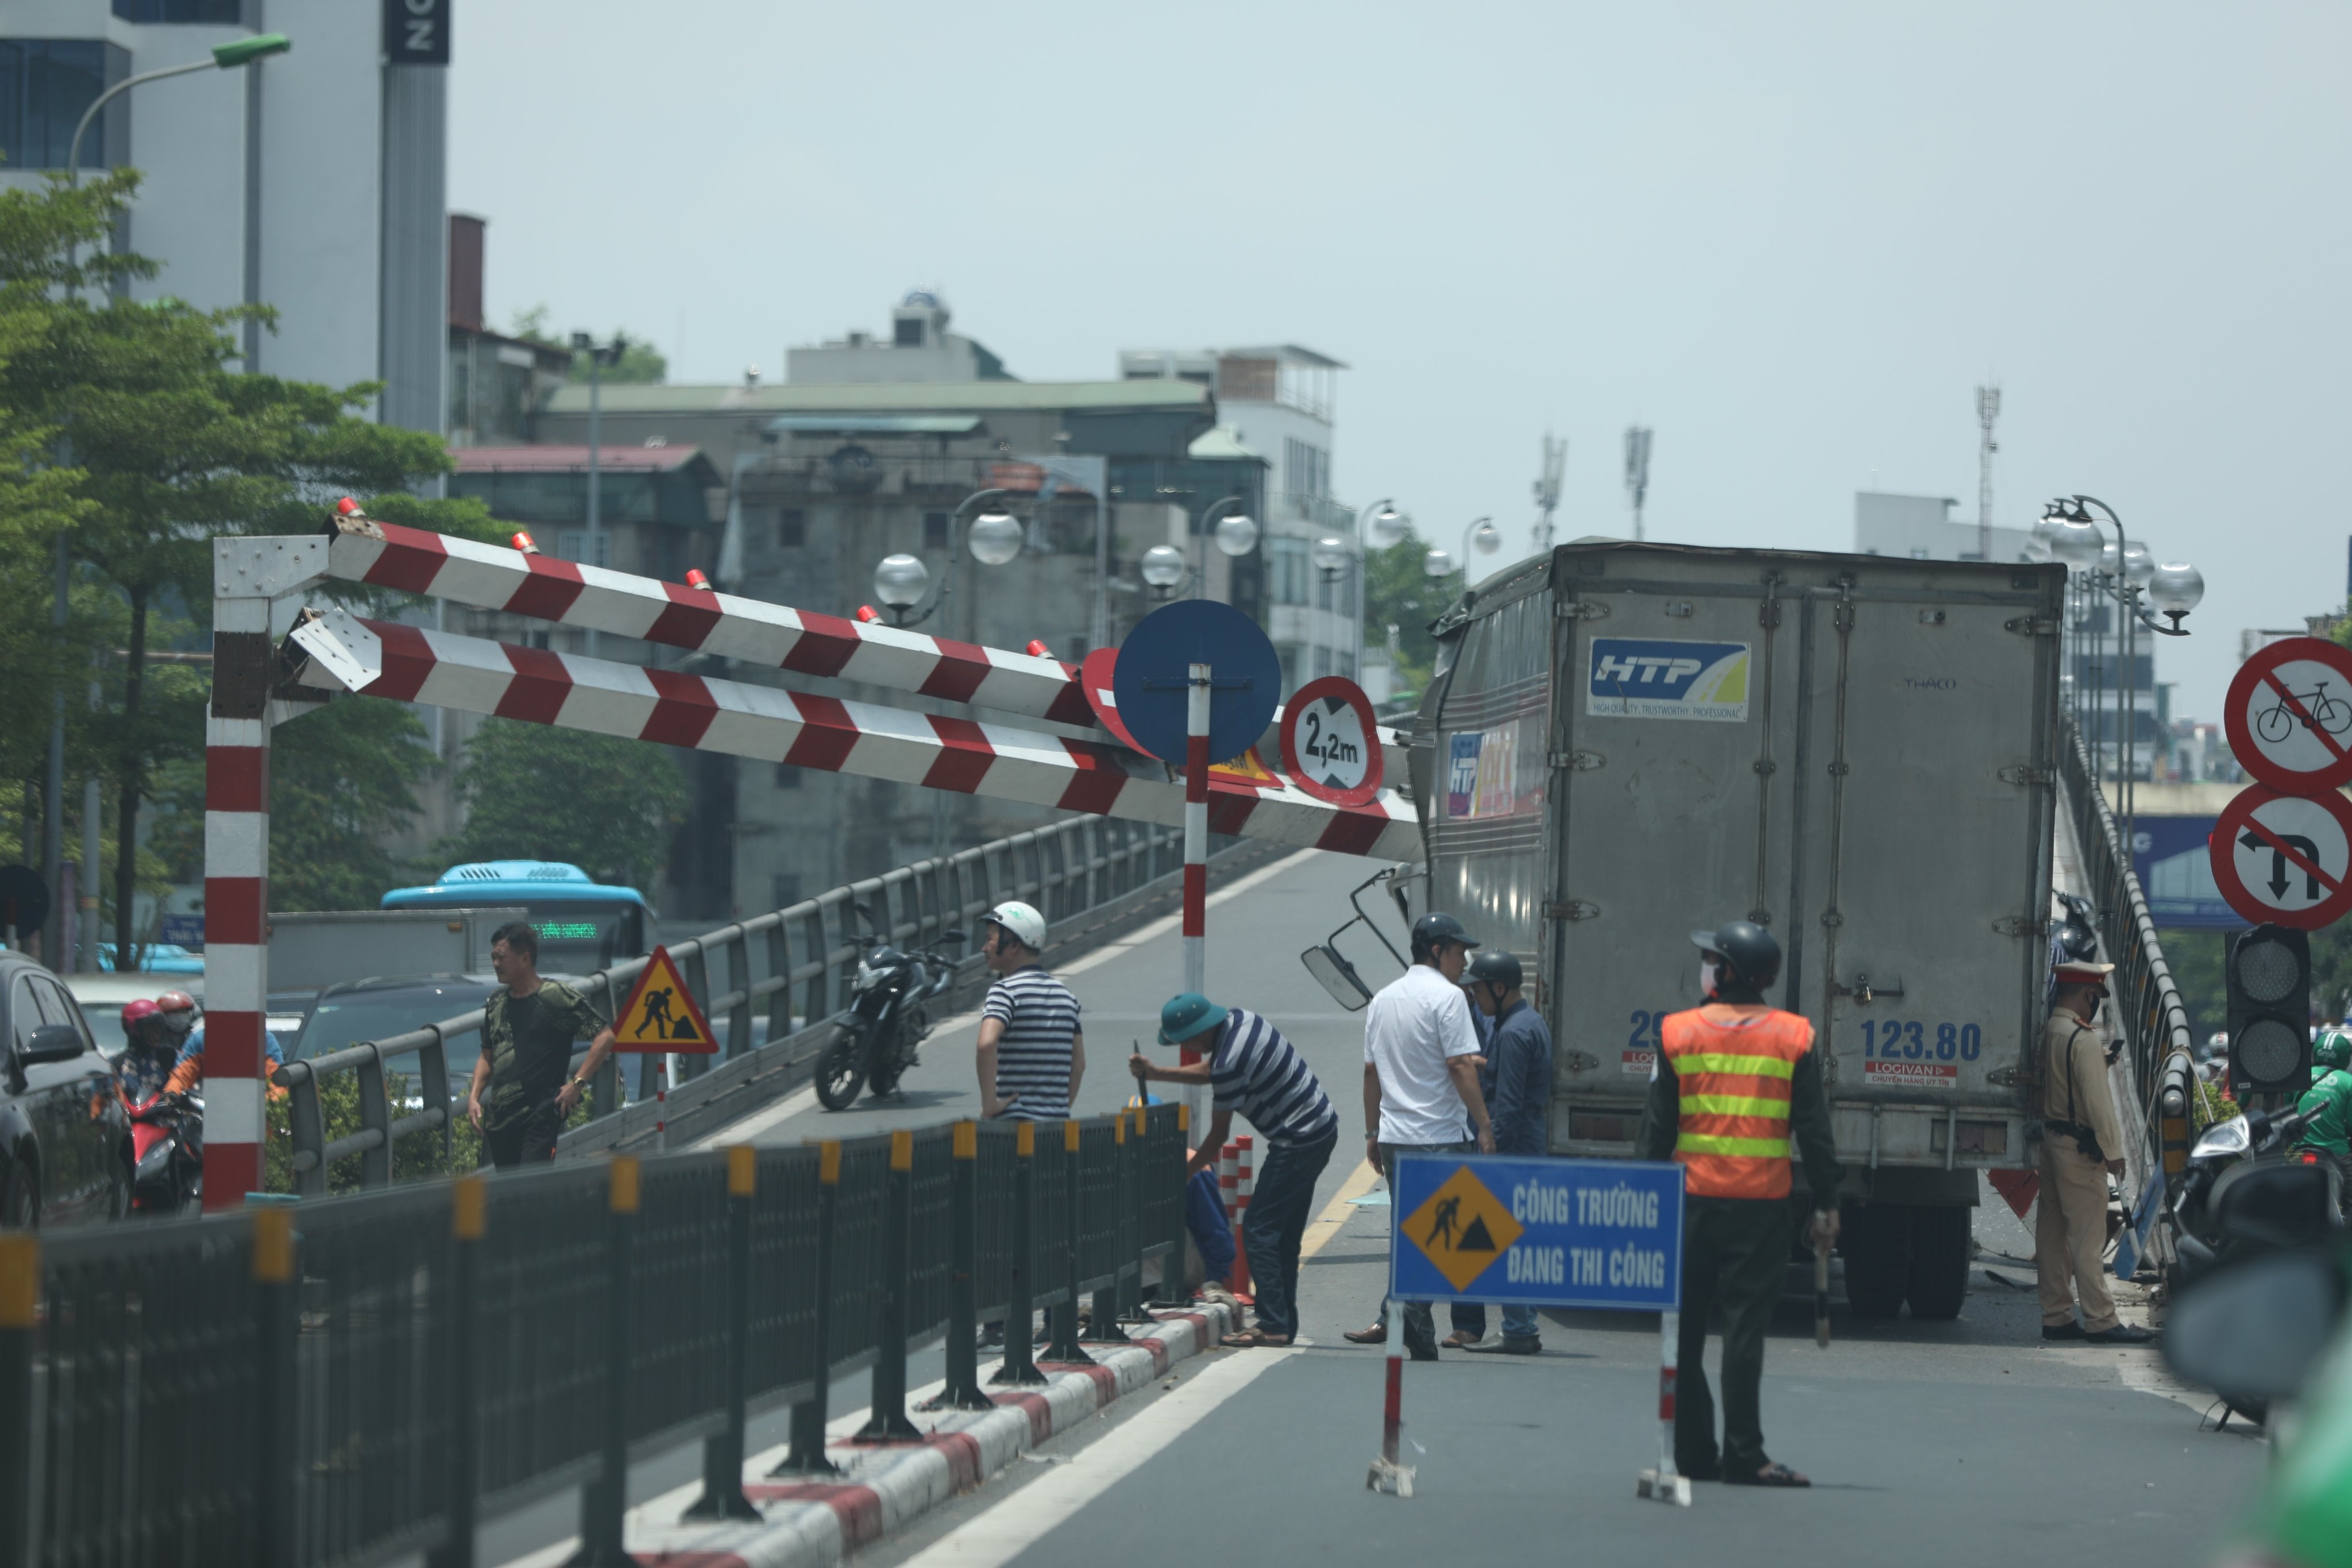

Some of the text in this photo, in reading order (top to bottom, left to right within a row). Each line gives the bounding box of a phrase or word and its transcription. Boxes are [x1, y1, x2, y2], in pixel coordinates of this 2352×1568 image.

[1594, 655, 1702, 683] HTP
[1903, 677, 1956, 689] THACO
[1593, 703, 1610, 713] HIGH
[1642, 705, 1689, 715] TRUSTWORTHY
[1693, 707, 1739, 718] PROFESSIONAL
[1305, 712, 1358, 769] 2,2m
[1860, 1019, 1981, 1061] 123.80
[1875, 1063, 1933, 1075] LOGIVAN
[1512, 1177, 1659, 1229] CÔNG TRƯỜNG
[1506, 1241, 1665, 1289] ĐANG THI CÔNG
